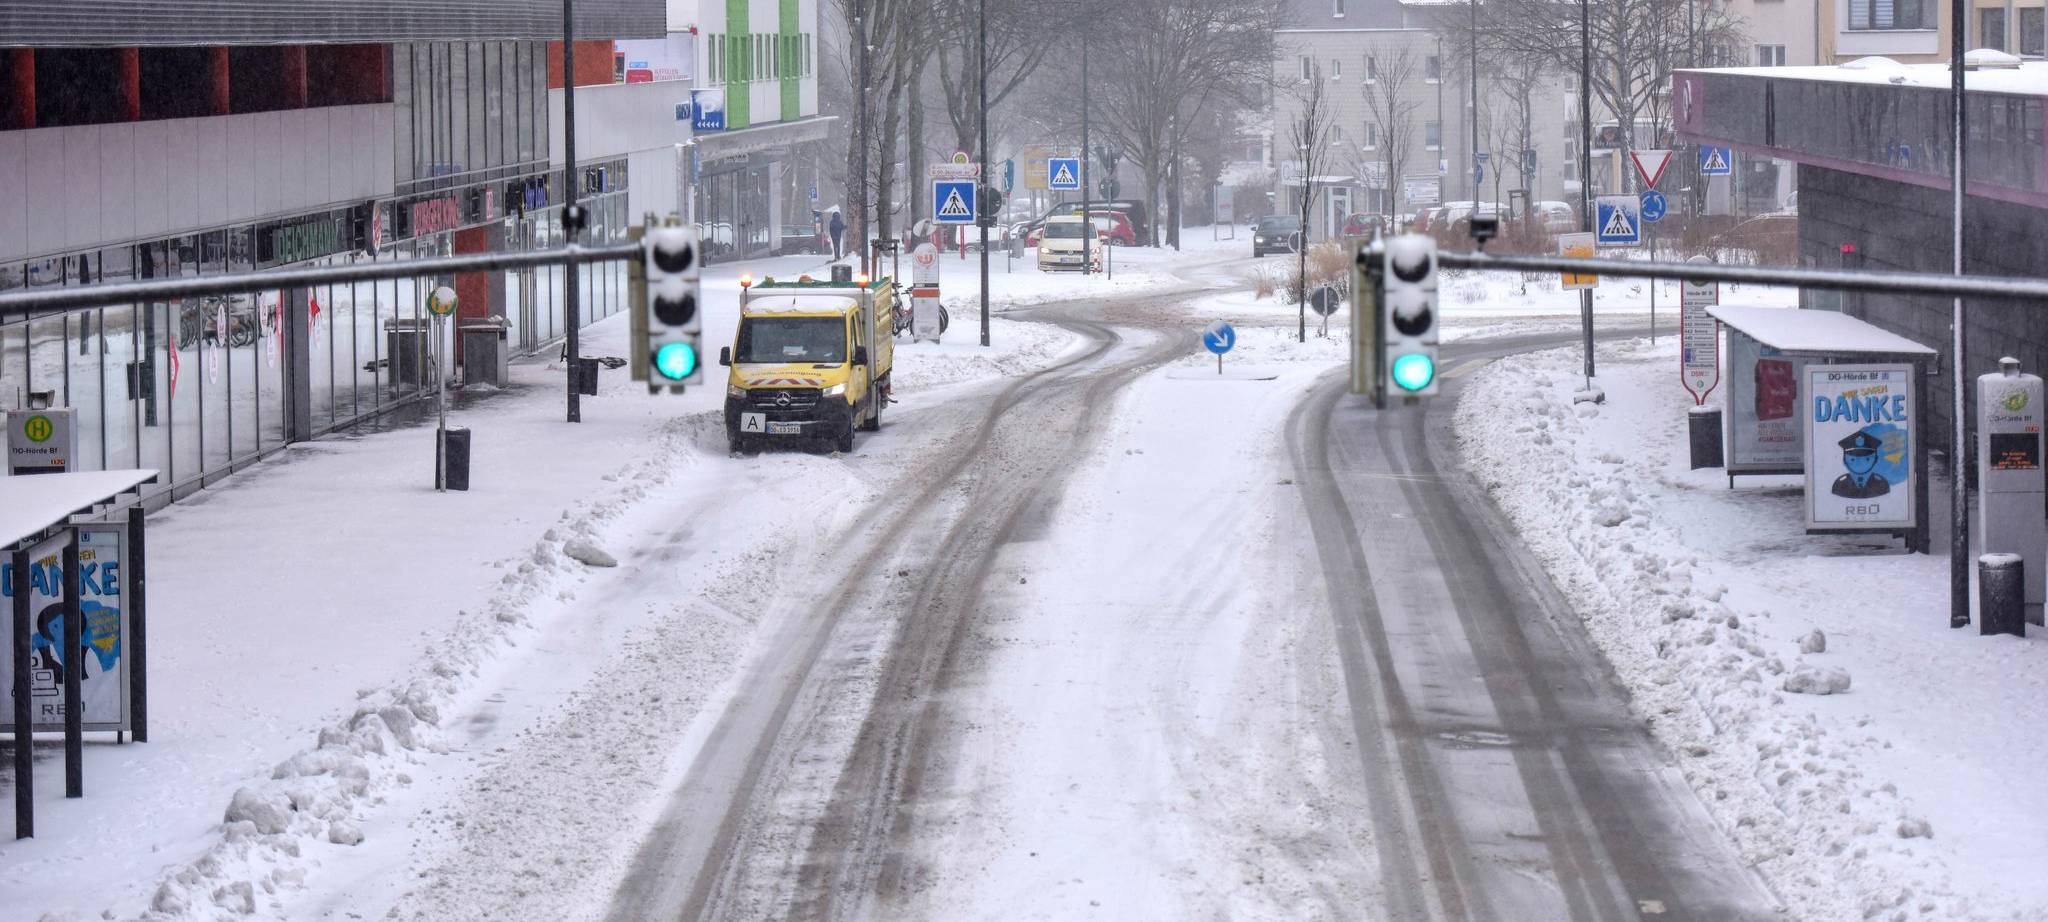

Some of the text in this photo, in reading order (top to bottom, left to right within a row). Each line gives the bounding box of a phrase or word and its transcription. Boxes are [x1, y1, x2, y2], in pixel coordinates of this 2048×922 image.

[278, 221, 338, 265] DEICHMANN
[1828, 372, 1867, 380] DO-Hörde
[1870, 372, 1878, 380] Bf
[1815, 394, 1908, 423] DANKE
[33, 421, 44, 437] H
[747, 416, 758, 430] A
